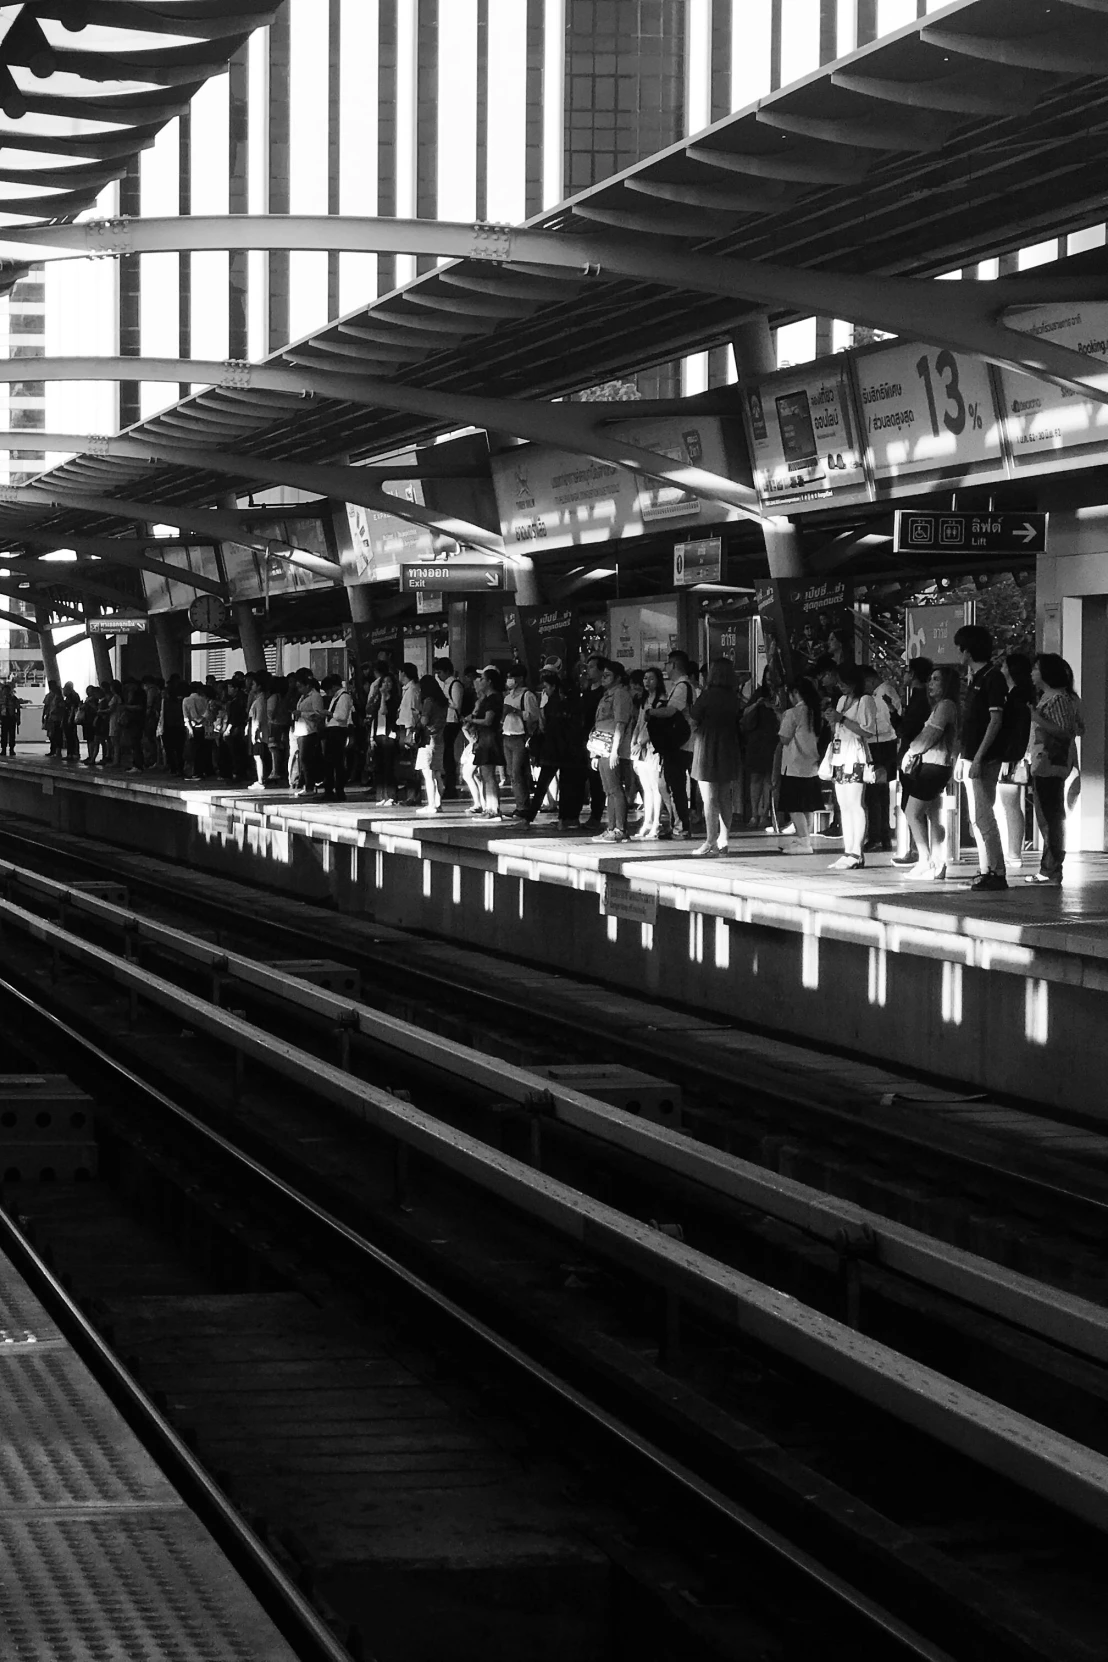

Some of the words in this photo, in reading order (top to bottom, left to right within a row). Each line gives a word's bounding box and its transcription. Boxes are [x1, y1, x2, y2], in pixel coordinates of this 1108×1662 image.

[972, 516, 1004, 533] ลิฟต์
[971, 537, 987, 546] Lift
[408, 568, 449, 578] ทางออก
[409, 580, 426, 588] Exit
